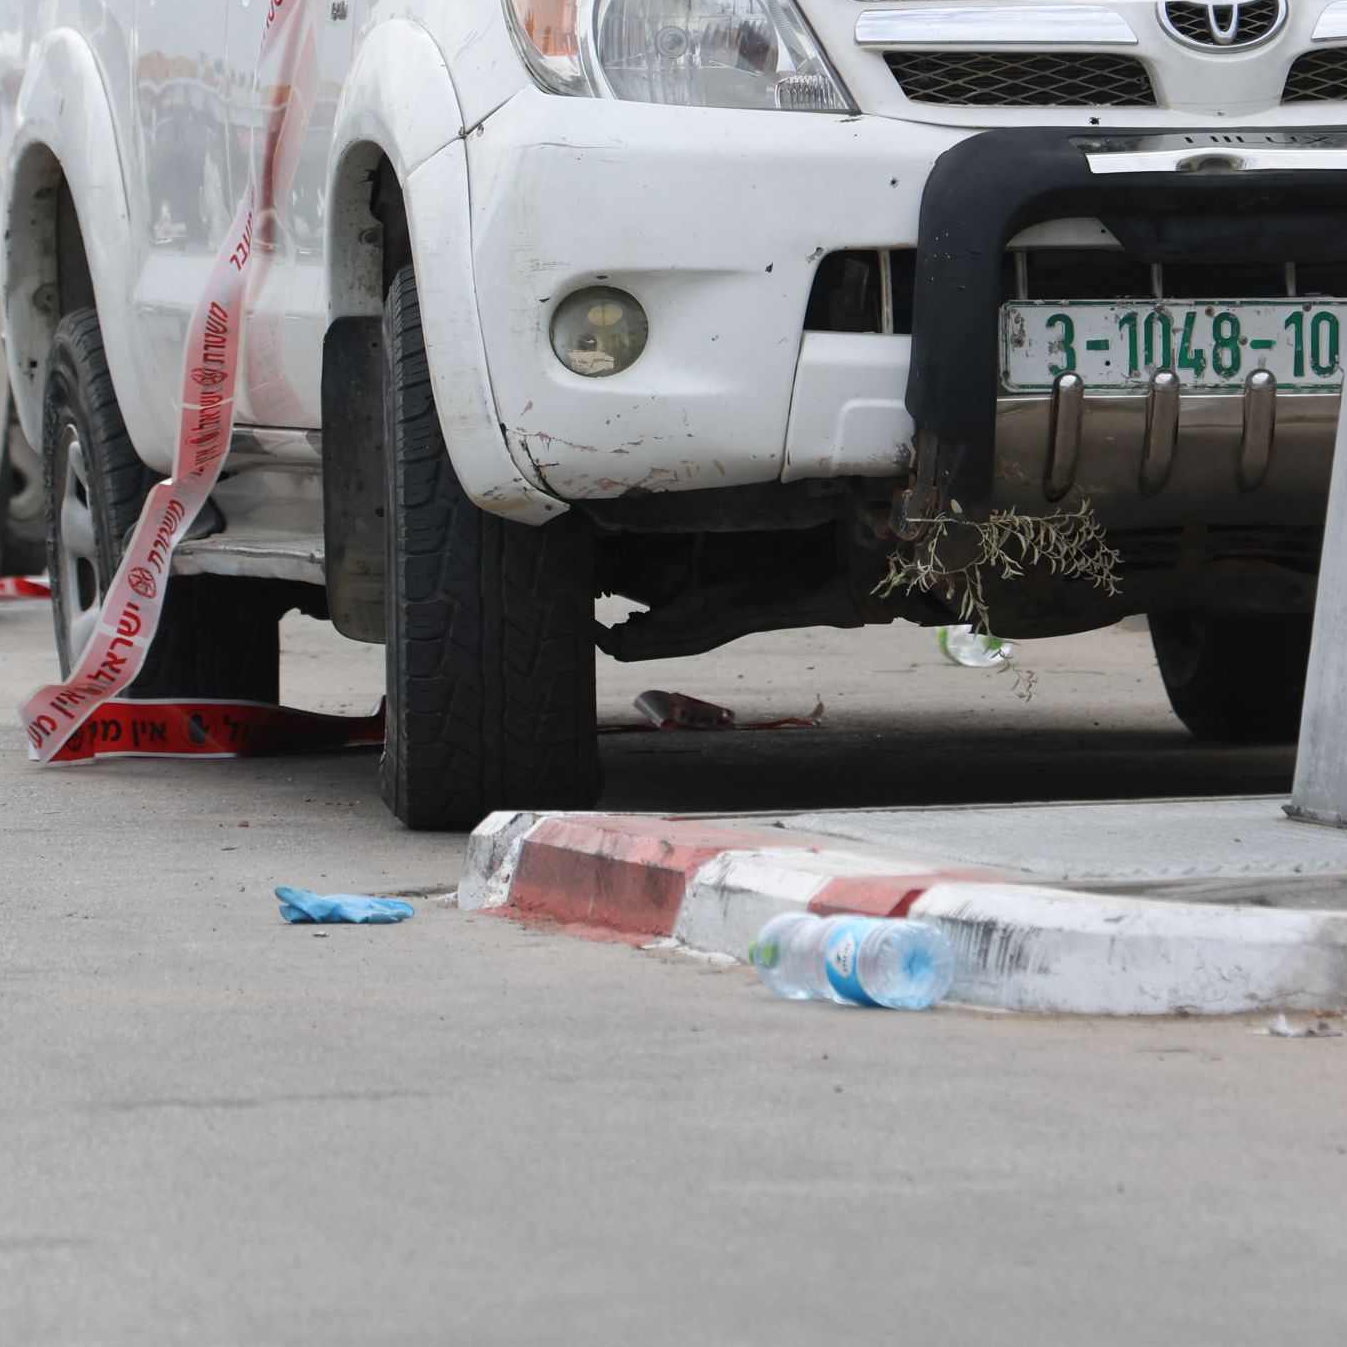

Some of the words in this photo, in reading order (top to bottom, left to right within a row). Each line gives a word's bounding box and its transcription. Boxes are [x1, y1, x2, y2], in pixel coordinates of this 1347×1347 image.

[203, 301, 230, 365] משטרת
[1045, 310, 1340, 379] 3-1048-10
[146, 499, 185, 574] משטרת
[86, 601, 142, 683] ישראל
[132, 720, 168, 749] אין
